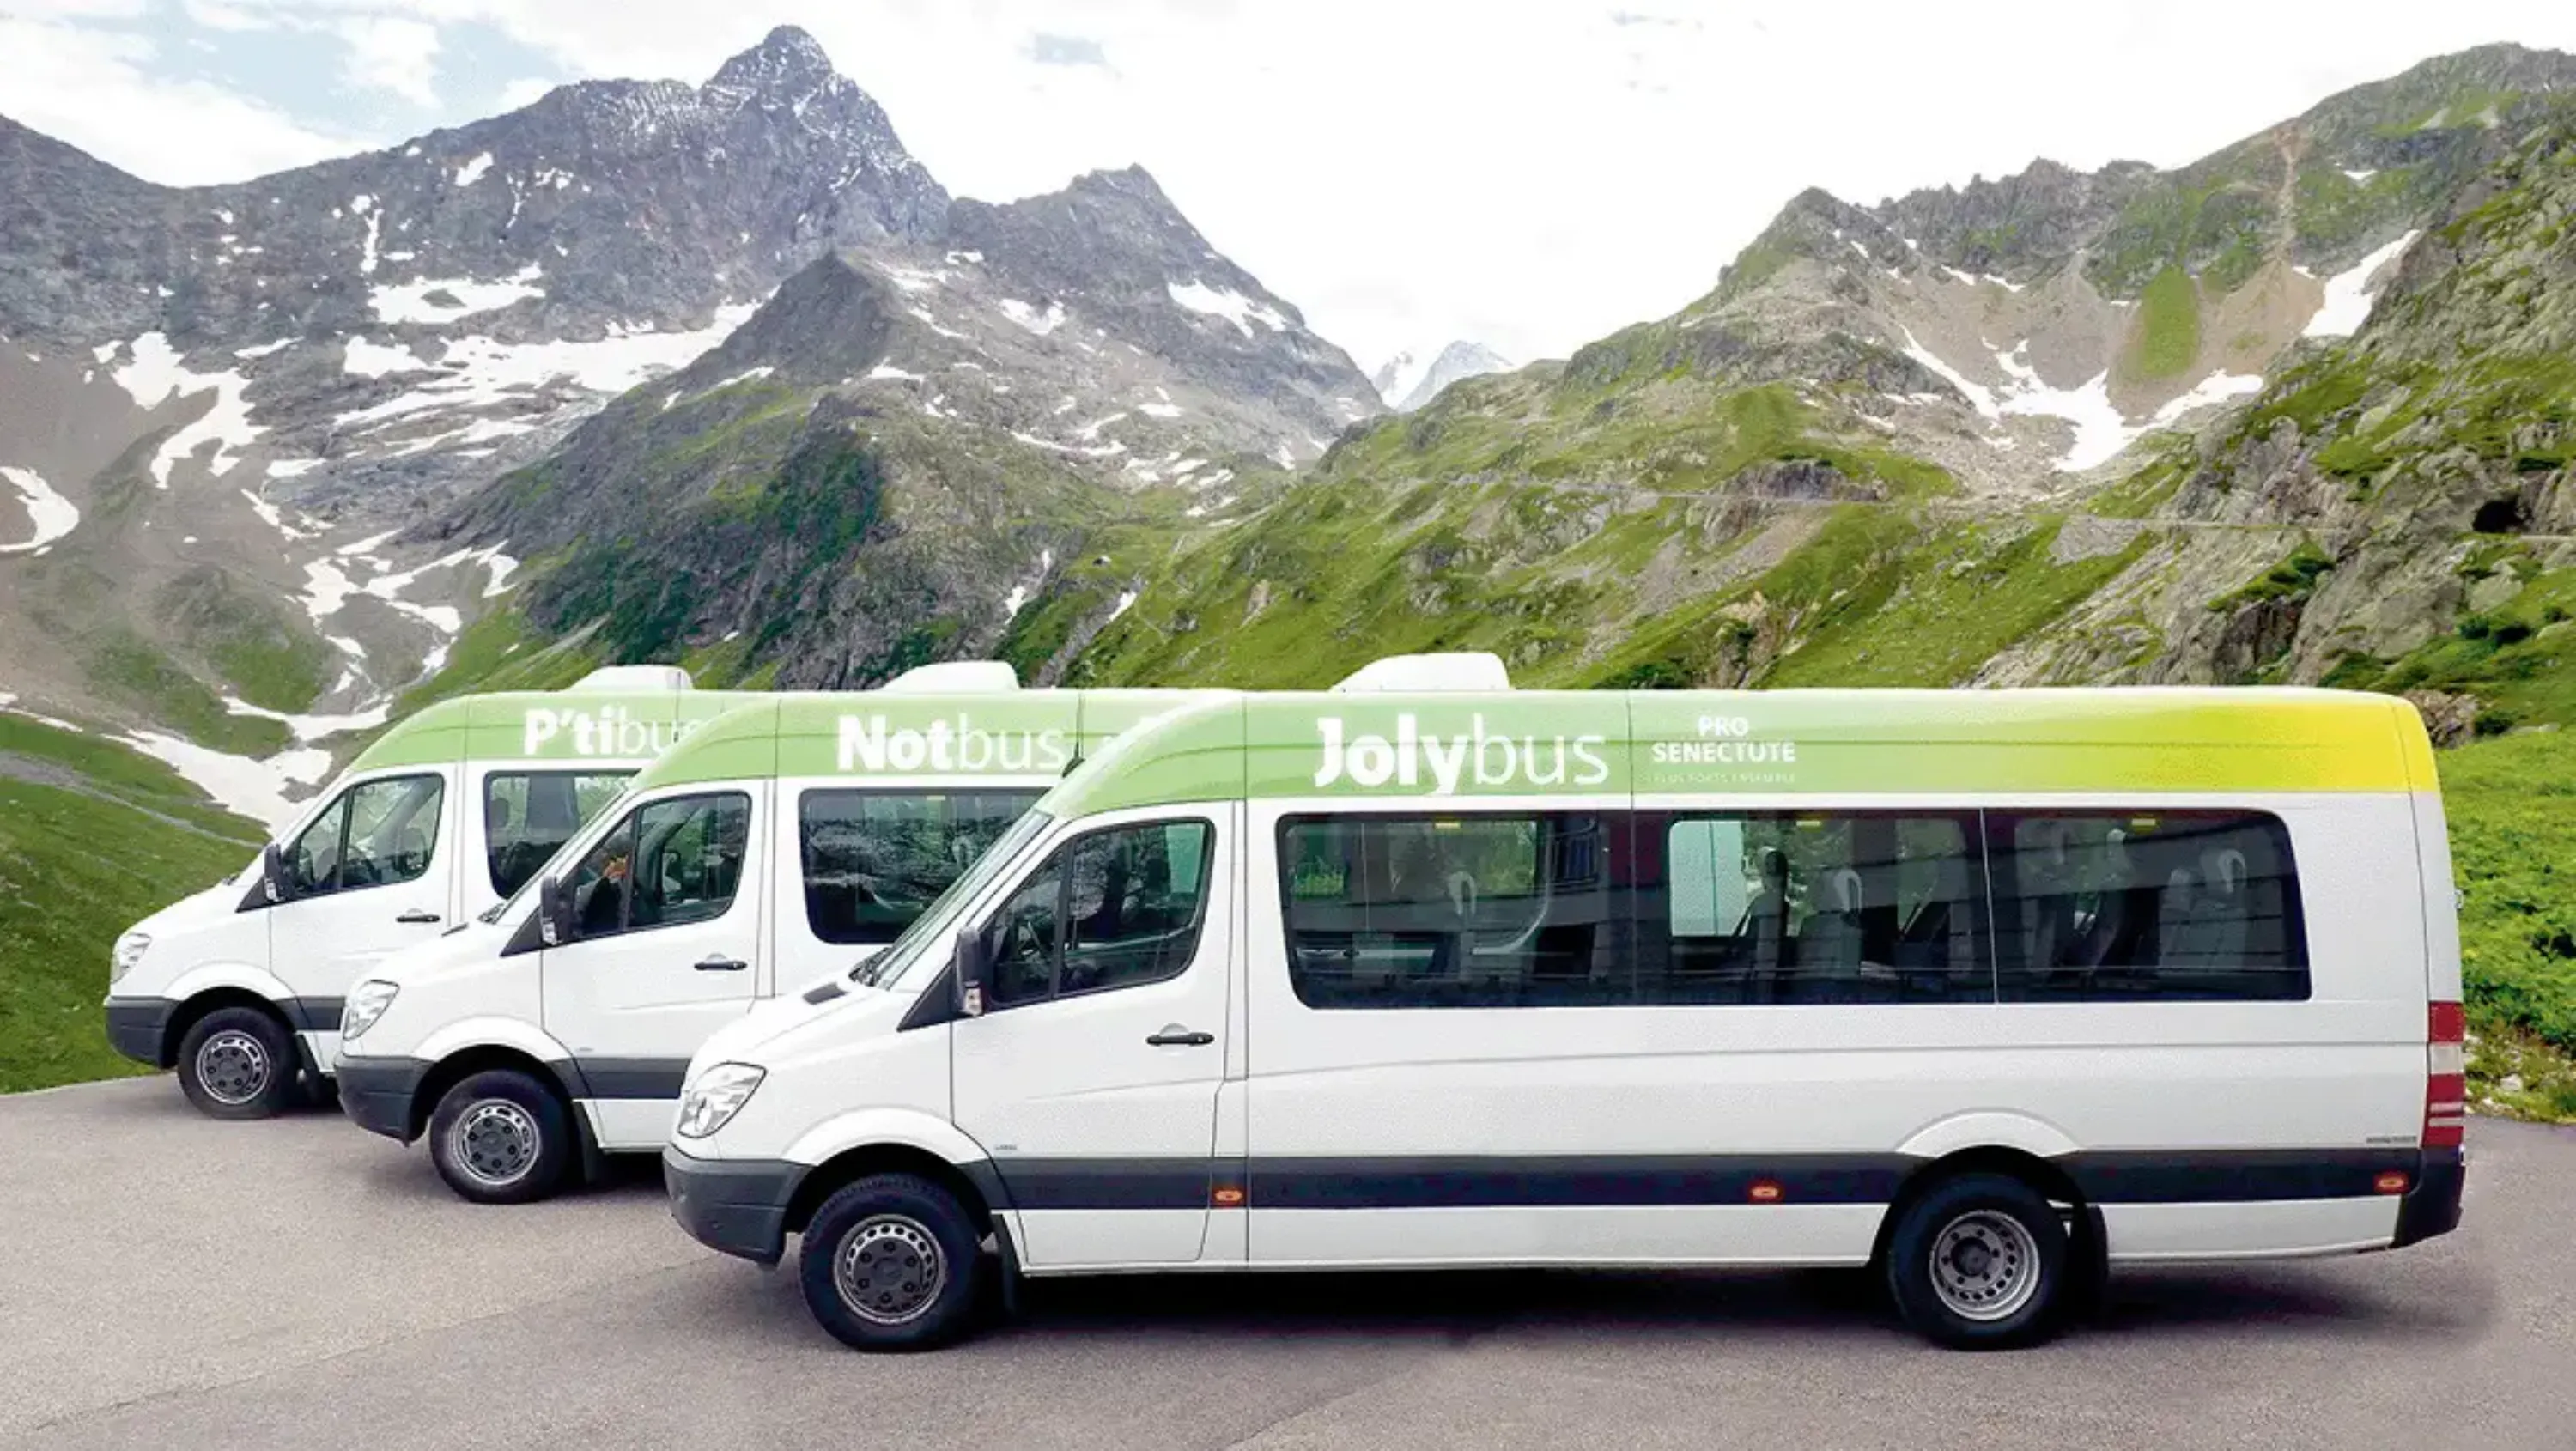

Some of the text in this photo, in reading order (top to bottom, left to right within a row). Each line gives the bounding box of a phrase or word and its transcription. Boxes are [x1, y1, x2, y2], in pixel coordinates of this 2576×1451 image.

[836, 713, 1065, 771] Notbus
[1698, 715, 1749, 737] PRO
[1314, 712, 1609, 794] Jolybus
[1652, 742, 1796, 762] SENECTUTE
